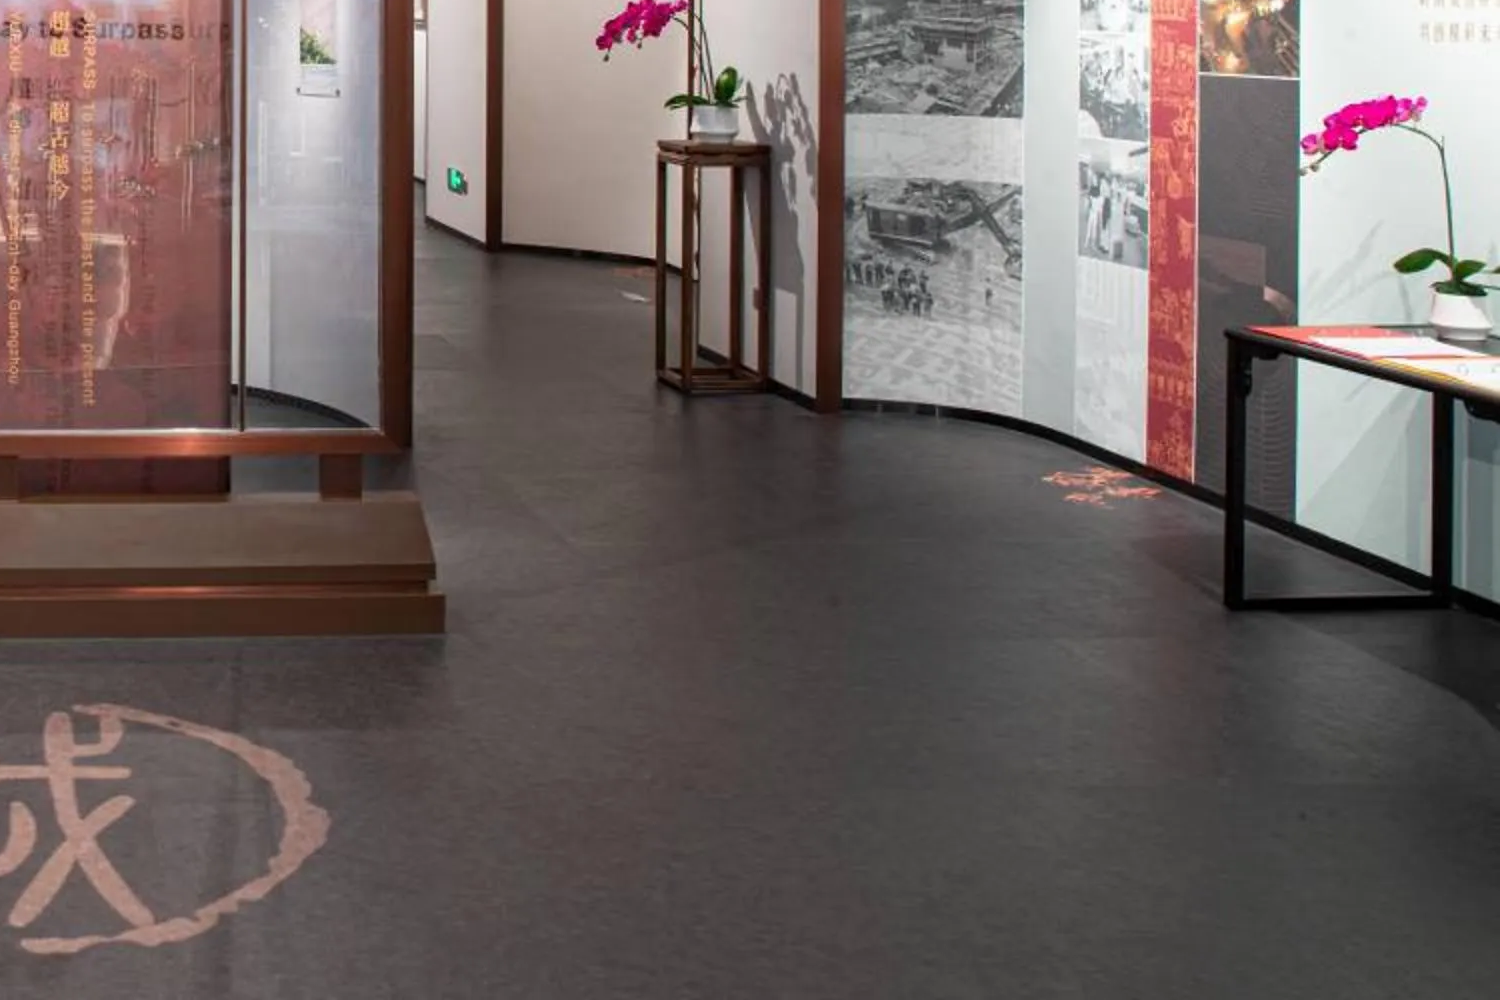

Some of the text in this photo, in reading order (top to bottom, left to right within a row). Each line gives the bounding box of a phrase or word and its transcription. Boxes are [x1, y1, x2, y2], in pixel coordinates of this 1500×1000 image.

[83, 10, 97, 89] SURPASS
[81, 124, 95, 192] surpass
[81, 199, 96, 224] the
[82, 271, 97, 303] and
[7, 299, 22, 384] Guangzhou
[83, 309, 97, 337] the
[82, 342, 97, 408] present
